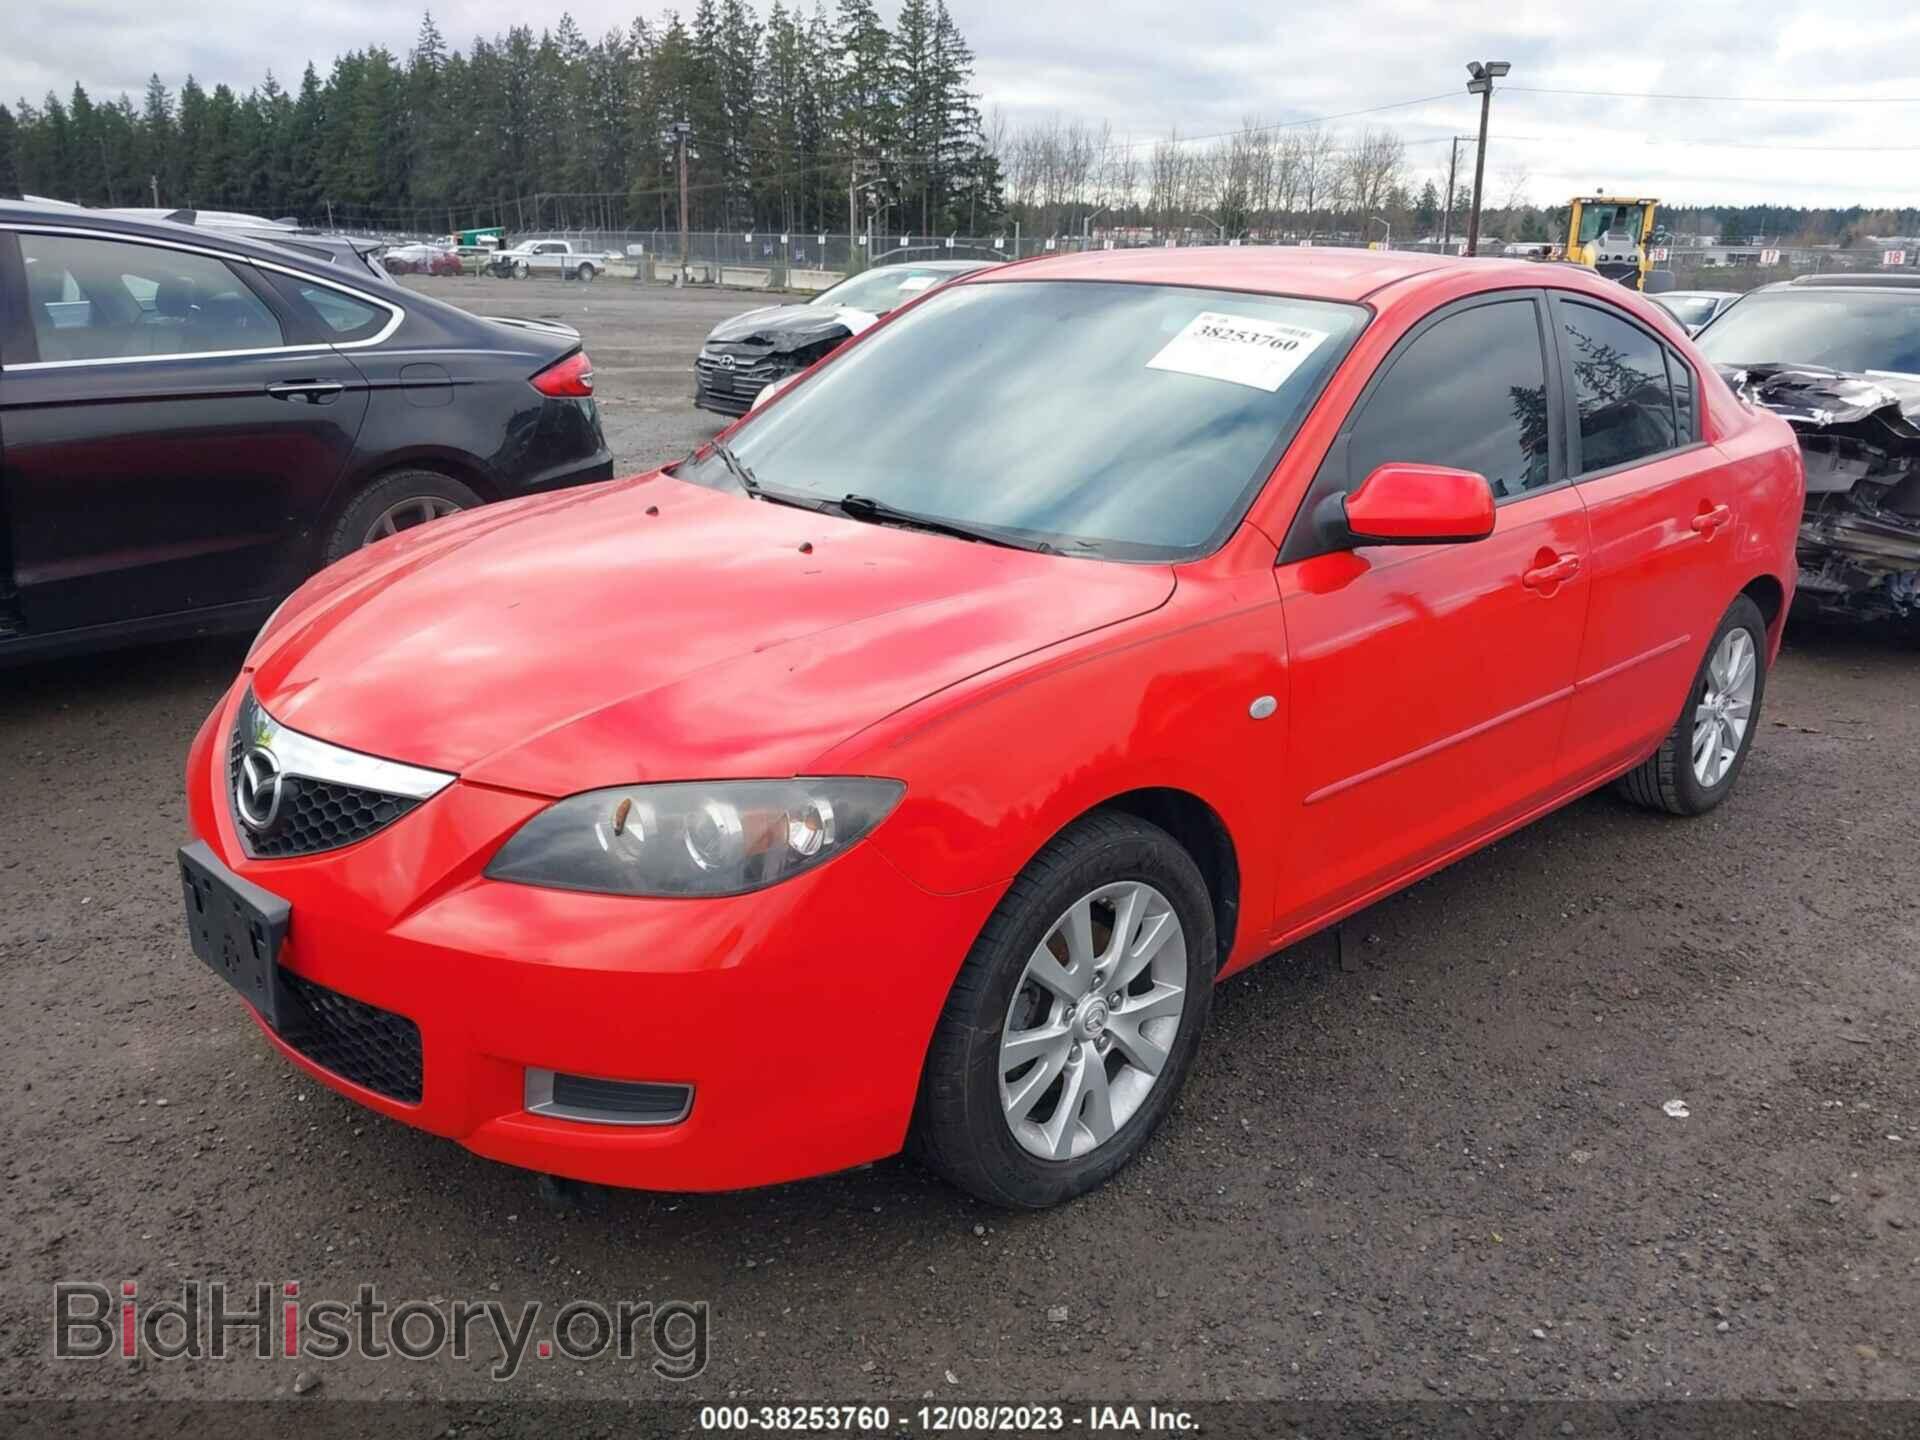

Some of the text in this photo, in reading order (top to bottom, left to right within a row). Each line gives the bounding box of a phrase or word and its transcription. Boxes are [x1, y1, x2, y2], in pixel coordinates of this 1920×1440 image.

[1762, 250, 1777, 263] 17
[1888, 252, 1902, 264] 18
[1194, 324, 1299, 351] 38253760
